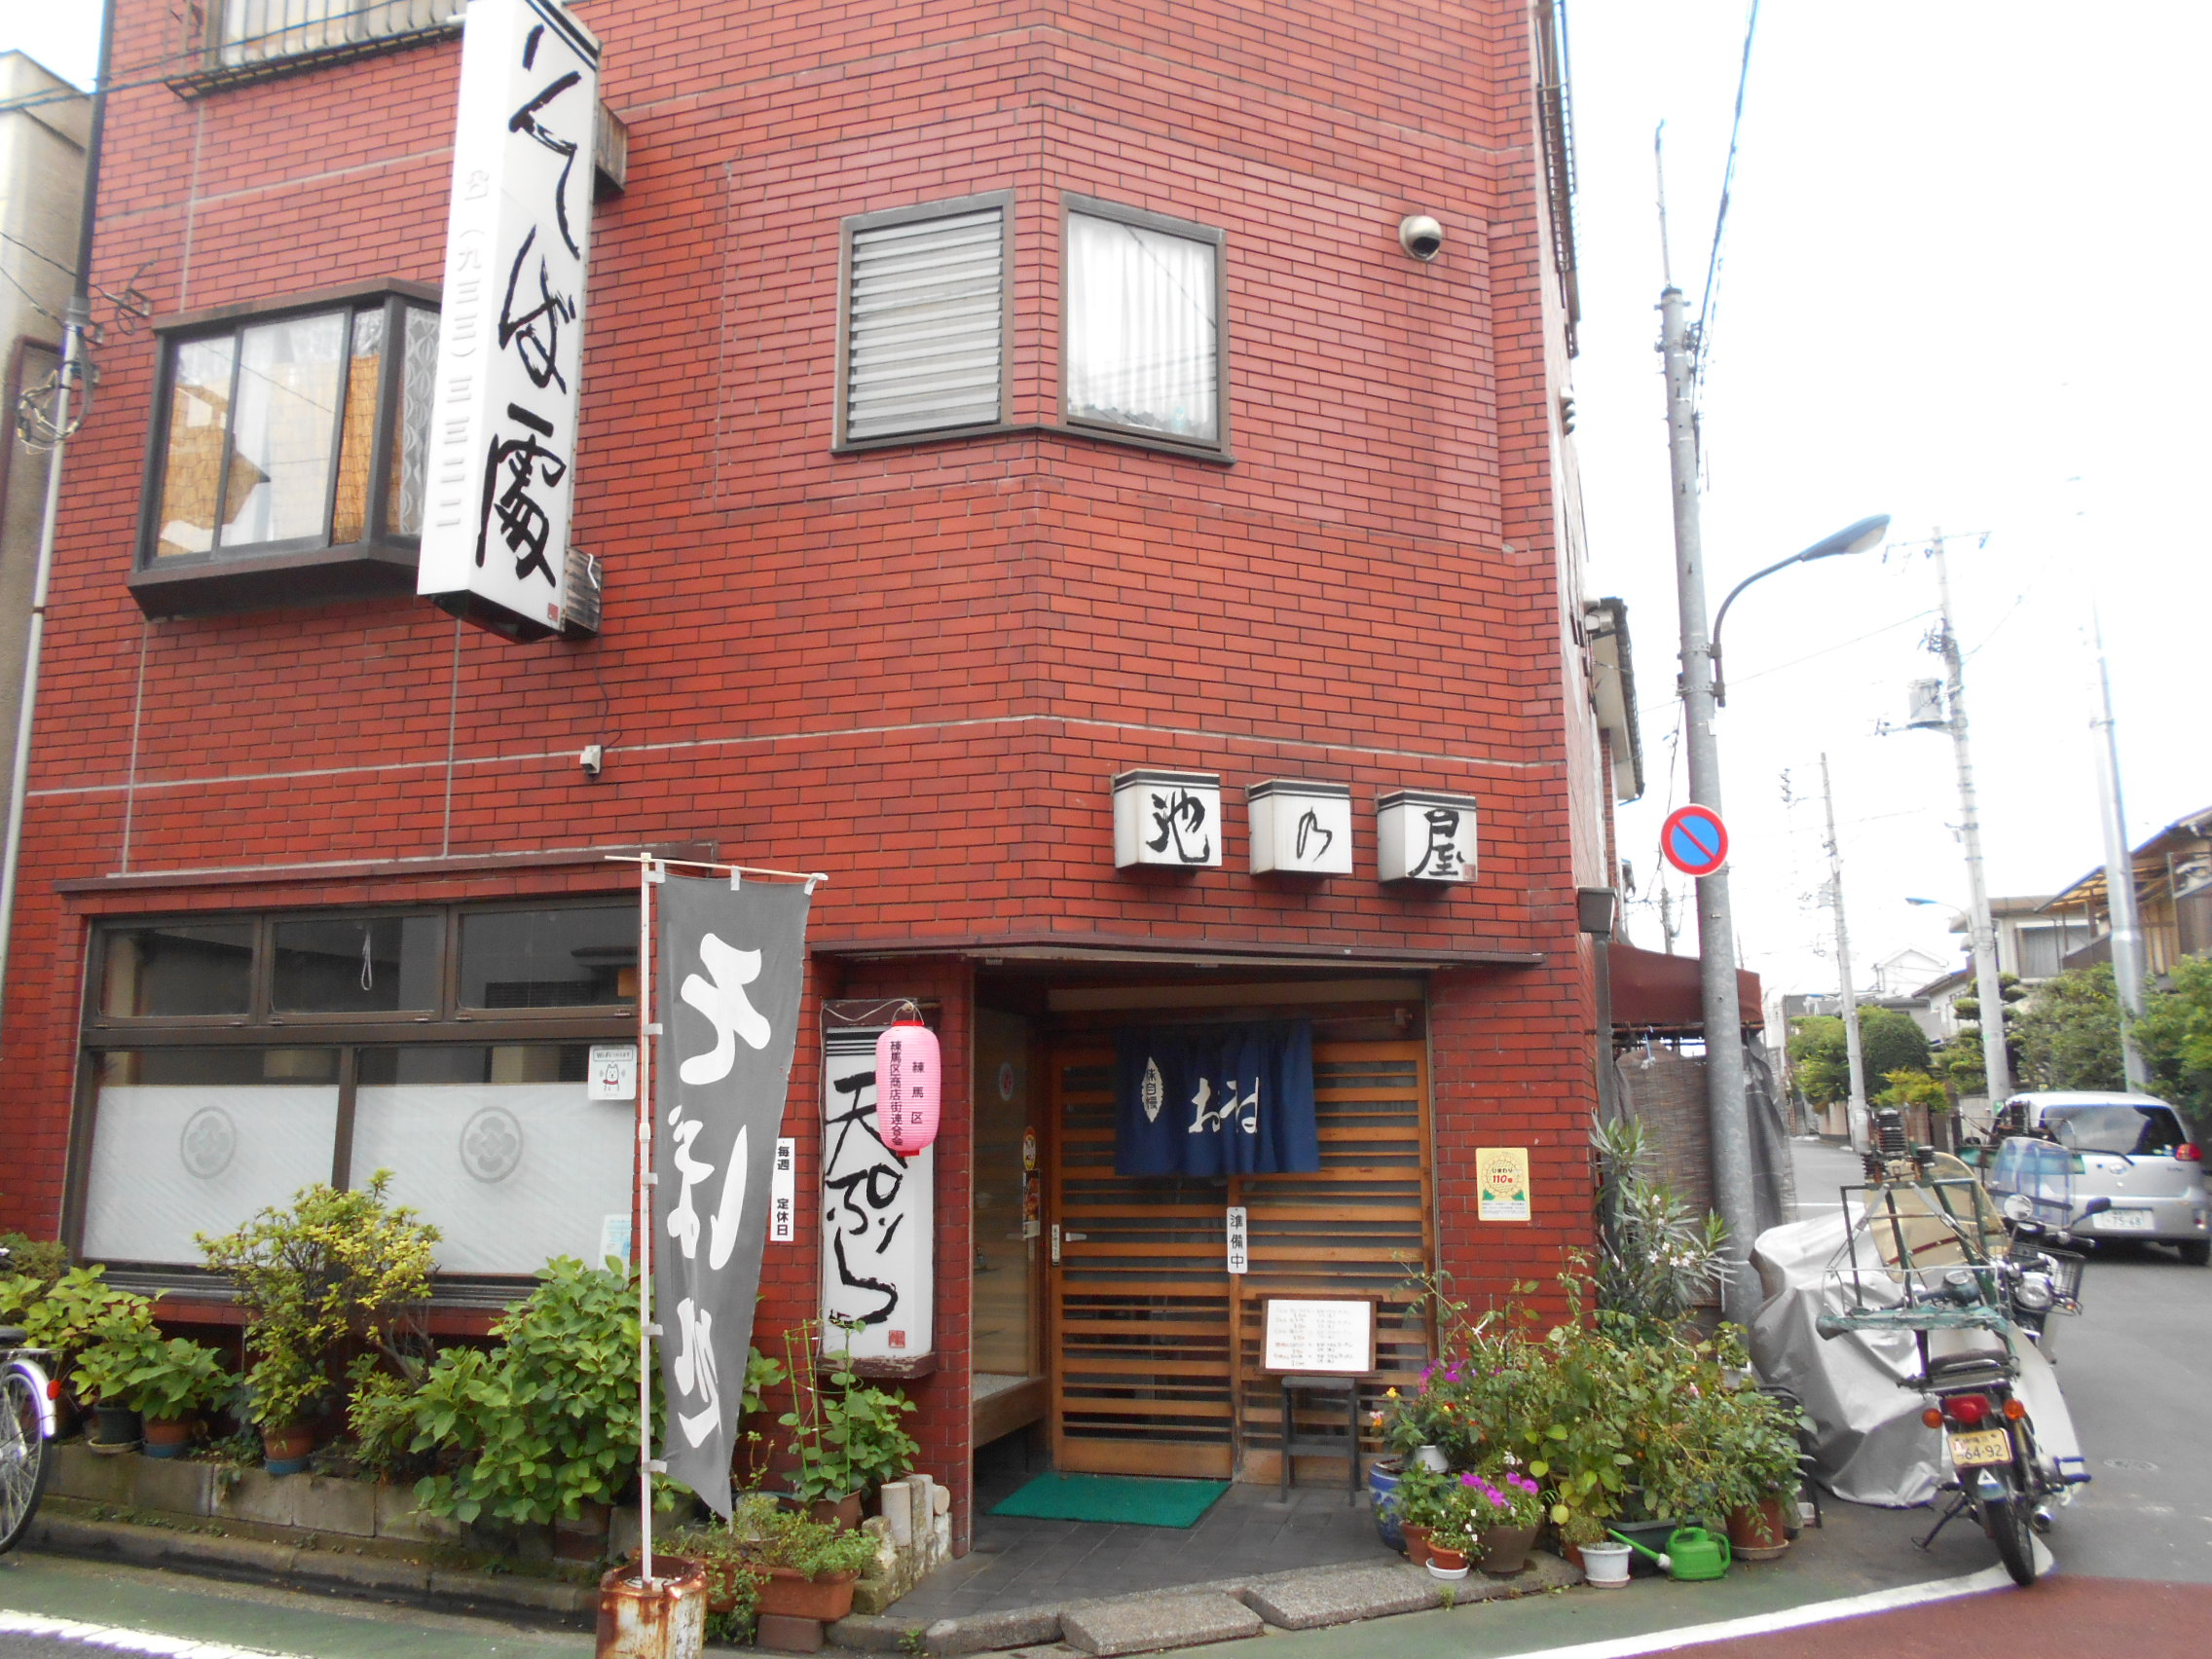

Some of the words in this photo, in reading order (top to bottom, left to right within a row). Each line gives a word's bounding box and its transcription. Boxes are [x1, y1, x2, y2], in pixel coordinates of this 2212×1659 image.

[911, 1061, 925, 1125] 練馬区
[775, 1145, 791, 1171] 毎週
[775, 1198, 791, 1236] 定休日
[826, 1070, 908, 1328] 天ぷら
[1230, 1213, 1244, 1269] 準備中
